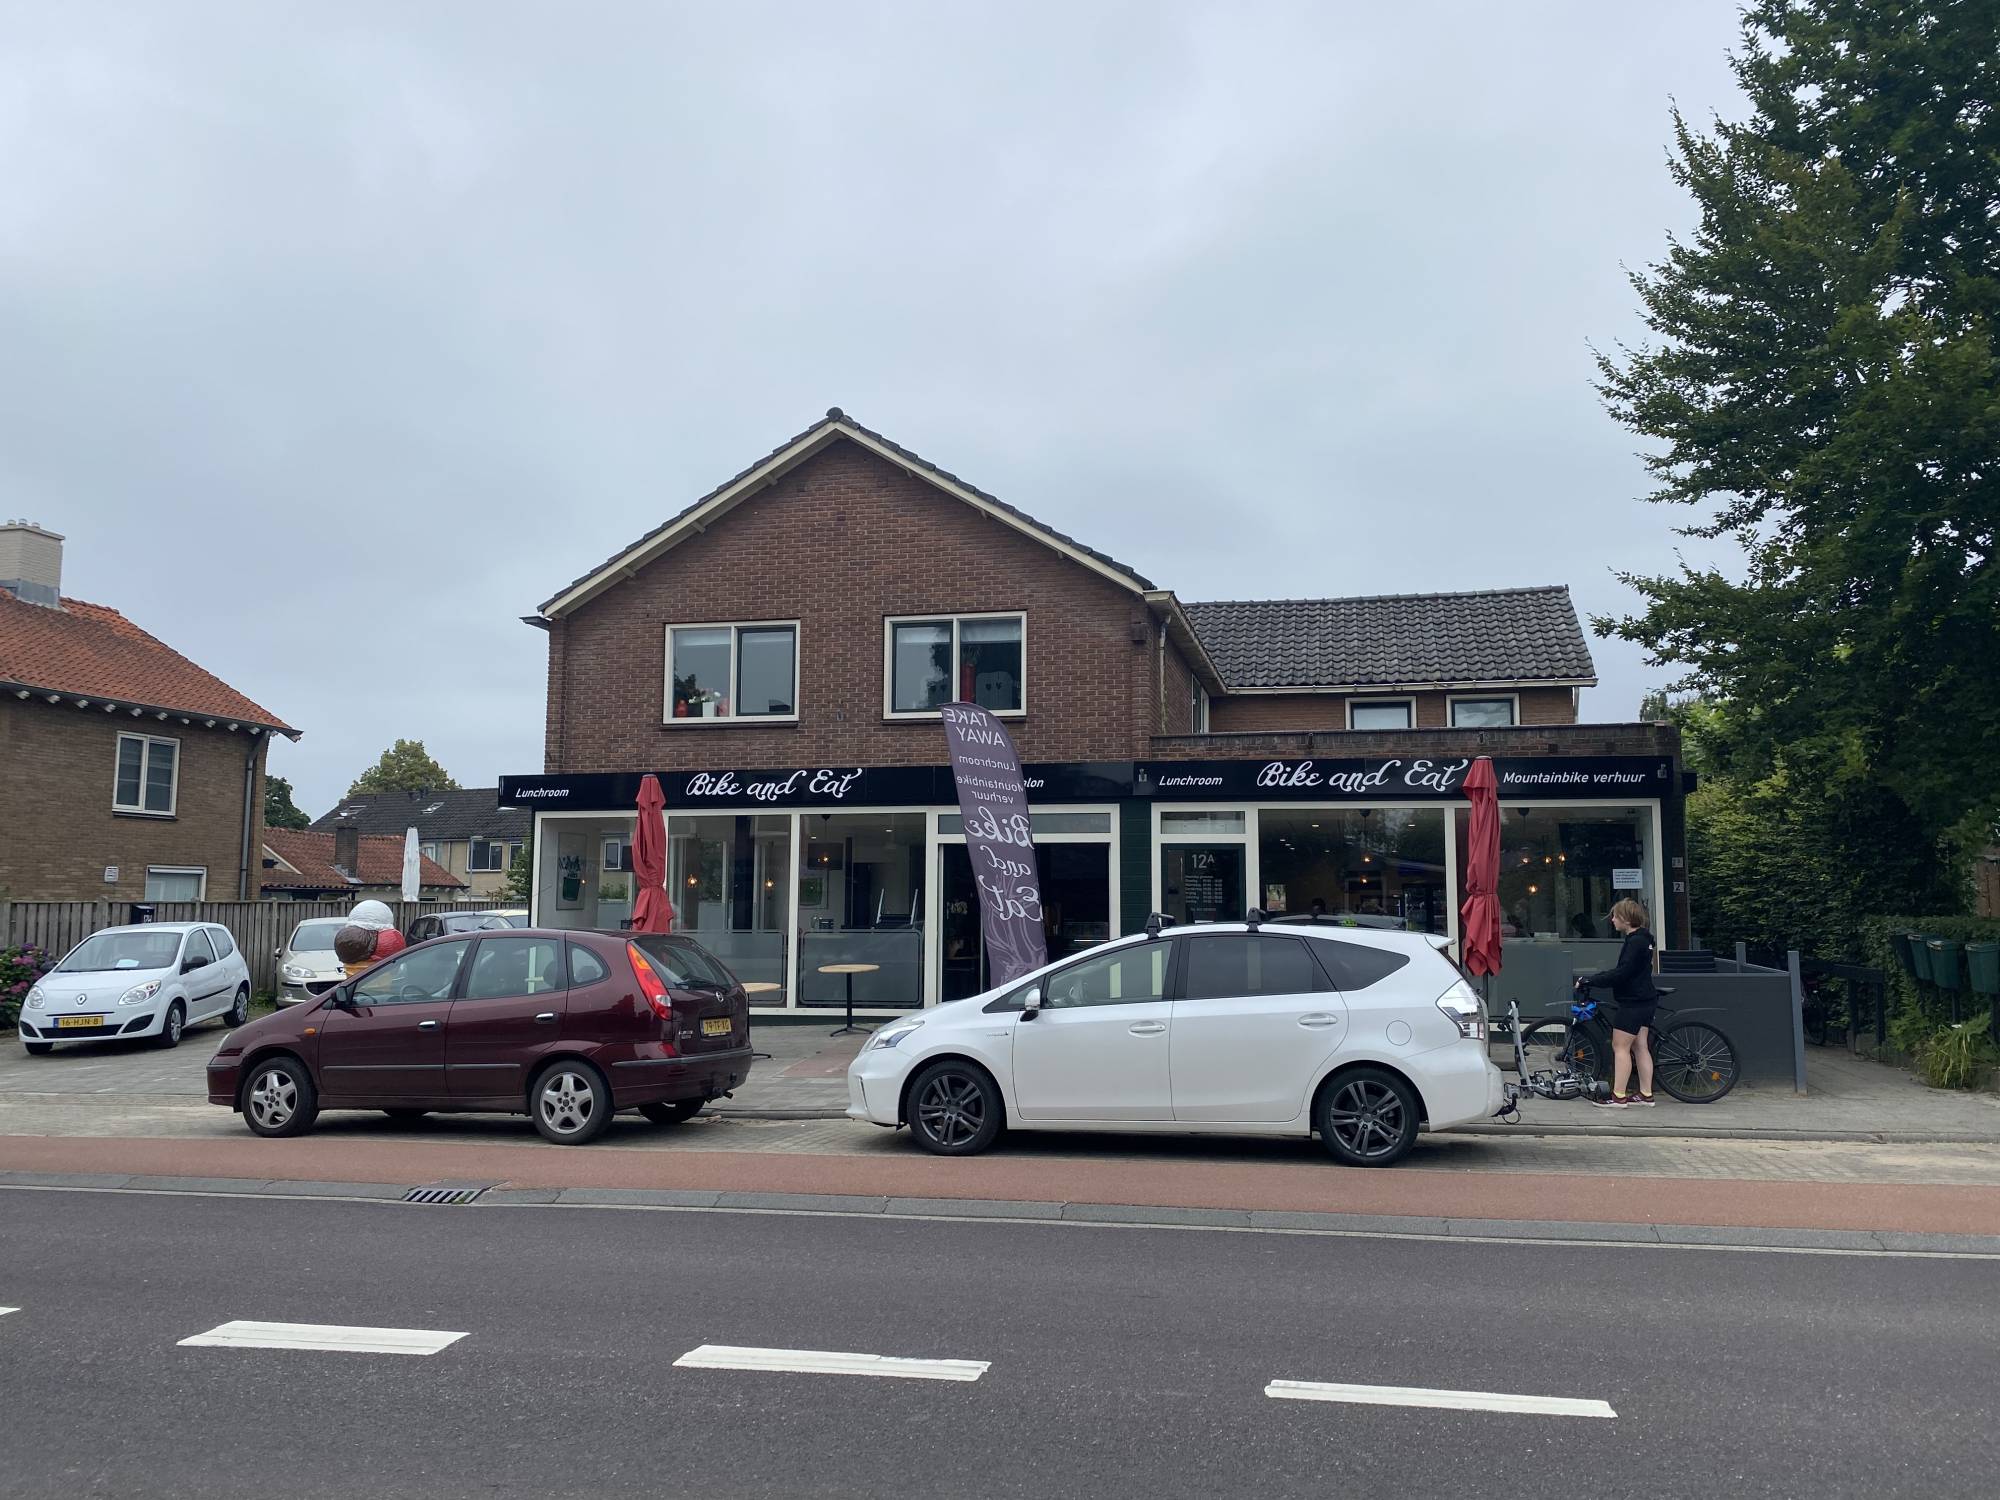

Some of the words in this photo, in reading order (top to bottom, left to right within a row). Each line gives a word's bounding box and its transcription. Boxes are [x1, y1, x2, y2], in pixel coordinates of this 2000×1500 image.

[1158, 774, 1223, 787] Lunchroom
[1256, 760, 1324, 787] Bike
[1328, 759, 1402, 792] and
[1404, 758, 1469, 792] Eat
[1503, 770, 1588, 785] Mountainbike
[1592, 770, 1646, 785] verhuur
[686, 772, 743, 796] Bike
[746, 770, 807, 800] and
[808, 767, 863, 799] Eat
[515, 786, 570, 798] Lunchroom
[1191, 854, 1215, 869] 12A
